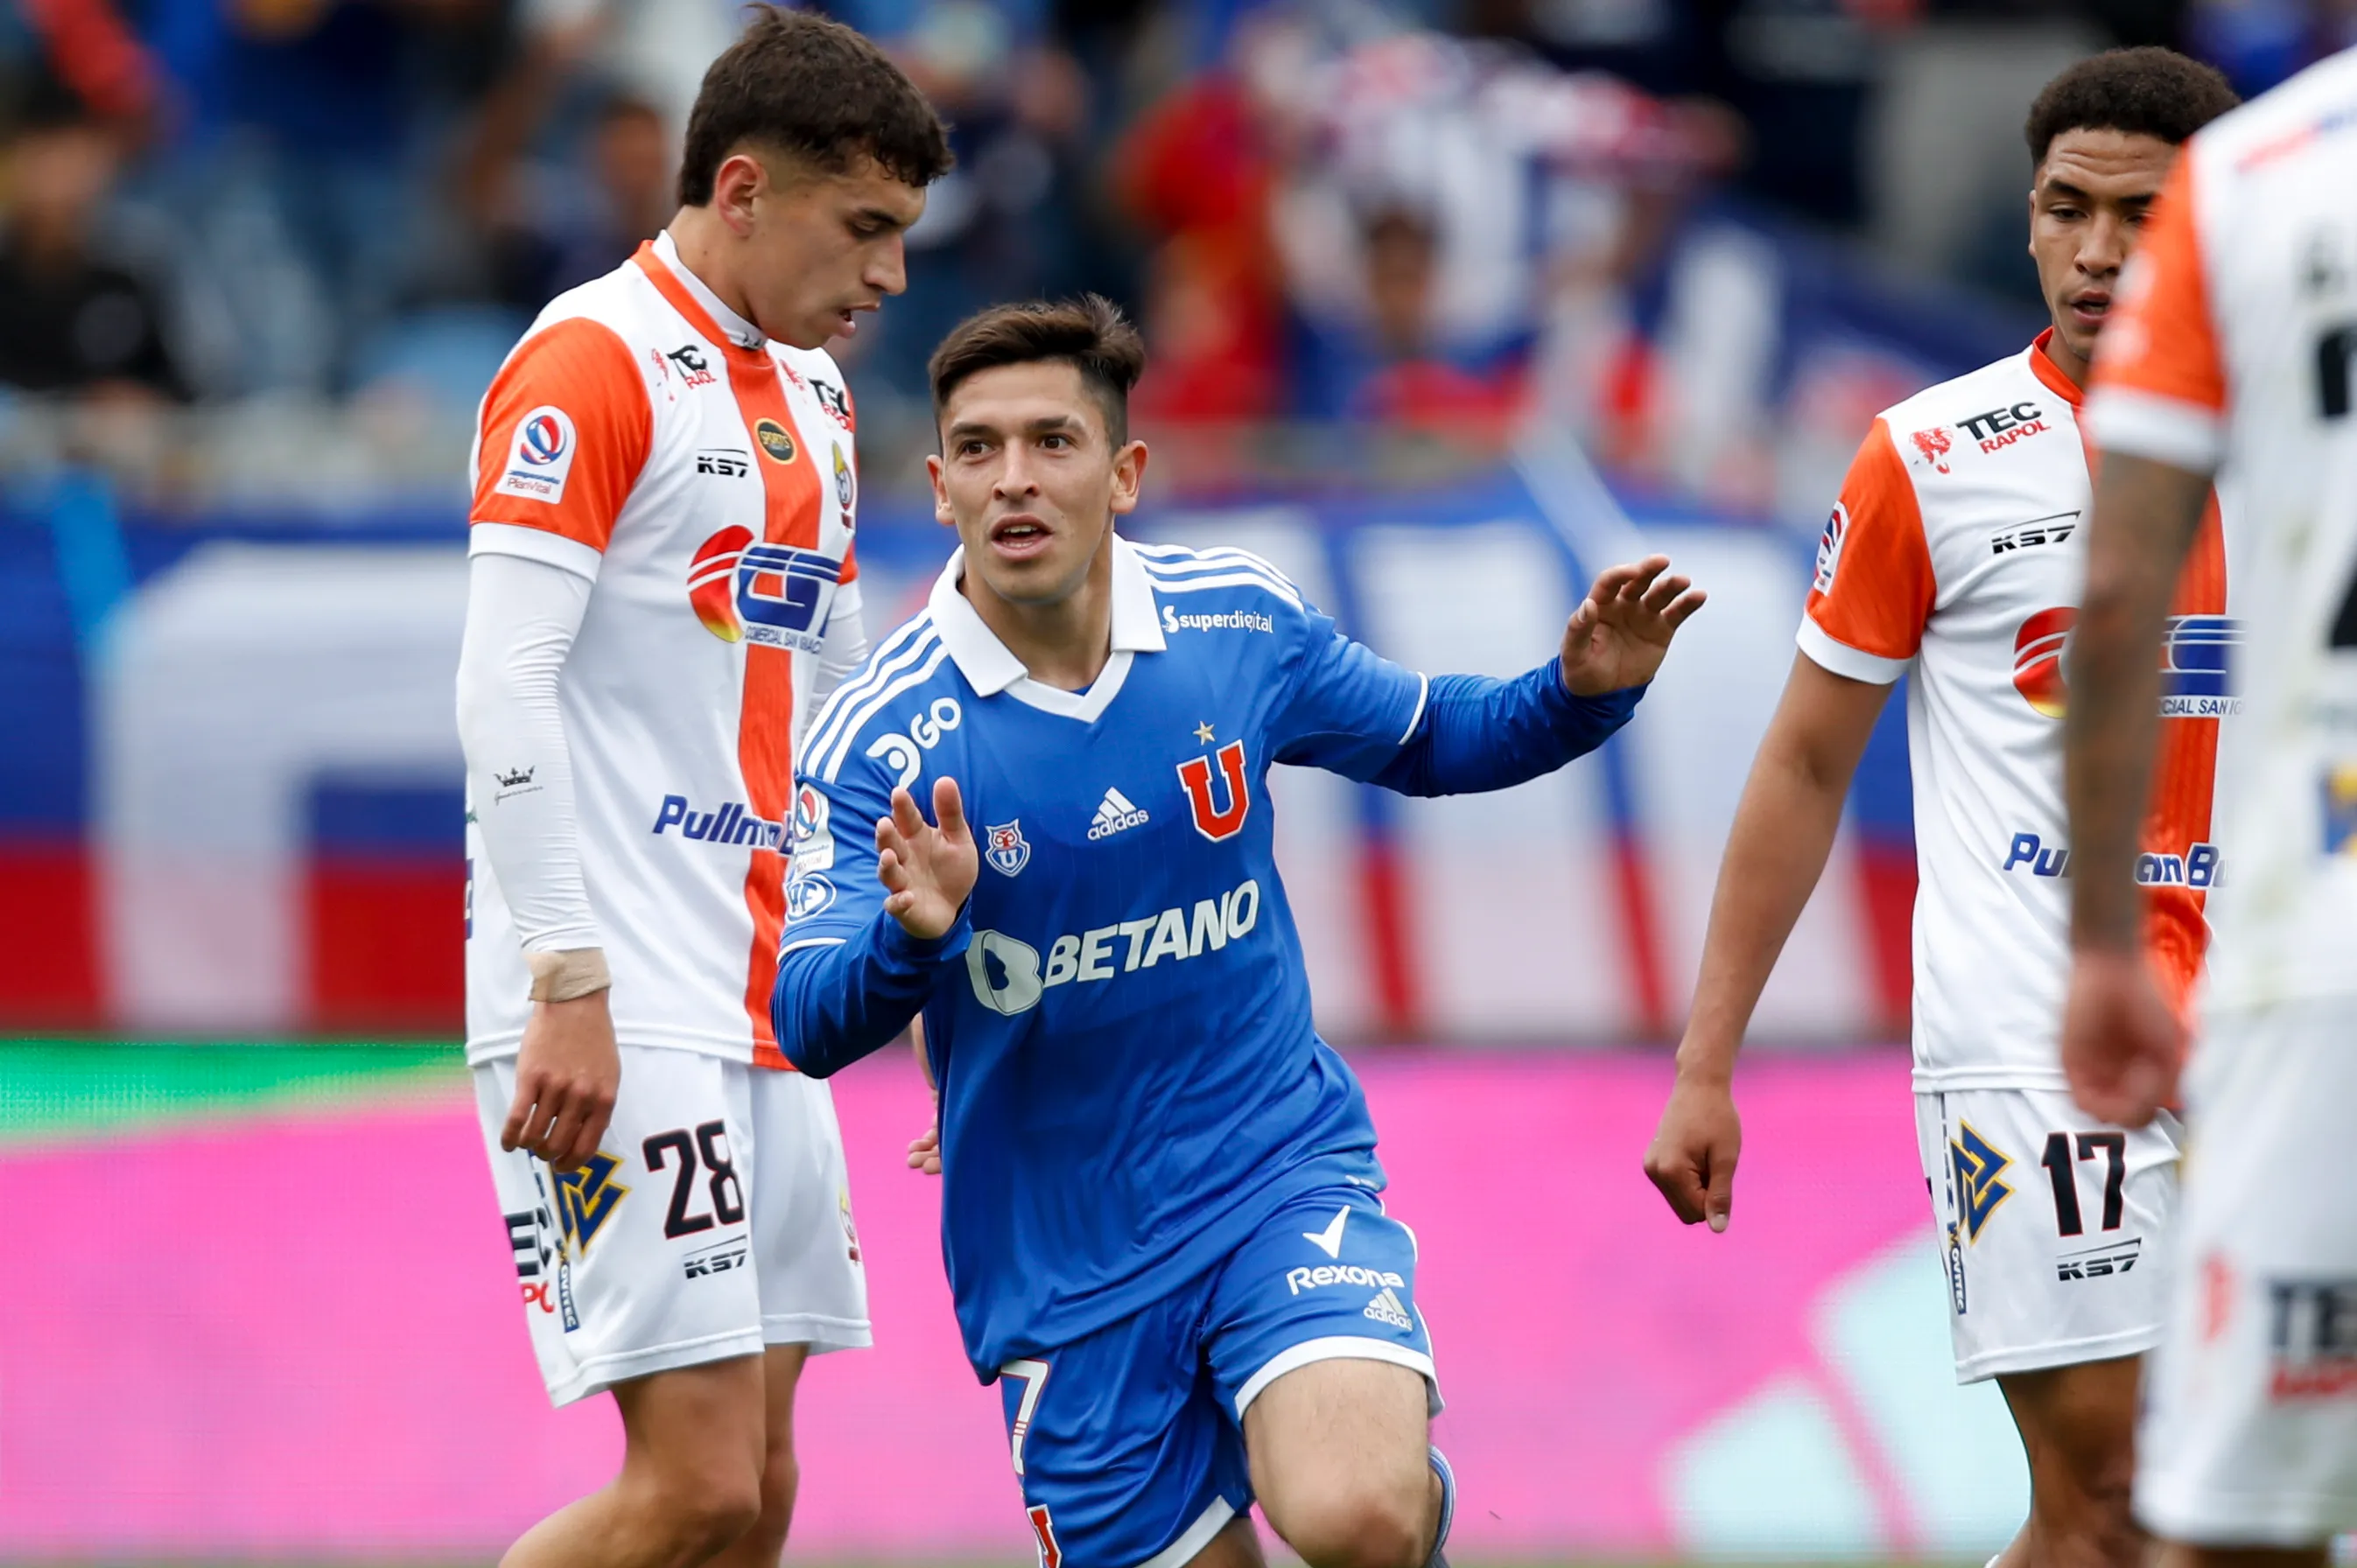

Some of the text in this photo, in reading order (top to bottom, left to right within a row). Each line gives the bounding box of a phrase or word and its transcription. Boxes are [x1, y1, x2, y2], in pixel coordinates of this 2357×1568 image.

[1955, 402, 2042, 440] TEC
[1979, 420, 2051, 454] RAPOL
[697, 456, 748, 478] KS7
[1991, 524, 2076, 555] KS7
[1180, 610, 1273, 634] superdigital
[2199, 699, 2226, 714] SAN
[1176, 739, 1250, 843] U
[1087, 808, 1149, 840] adidas
[1043, 878, 1260, 988] BETANO
[642, 1119, 746, 1240] 28
[2041, 1131, 2125, 1237] 17
[504, 1207, 553, 1277] EC
[684, 1249, 747, 1279] KS7
[2057, 1252, 2139, 1281] KS7
[1286, 1265, 1405, 1296] Rexona
[1363, 1306, 1413, 1332] adidas
[1000, 1357, 1052, 1476] 7
